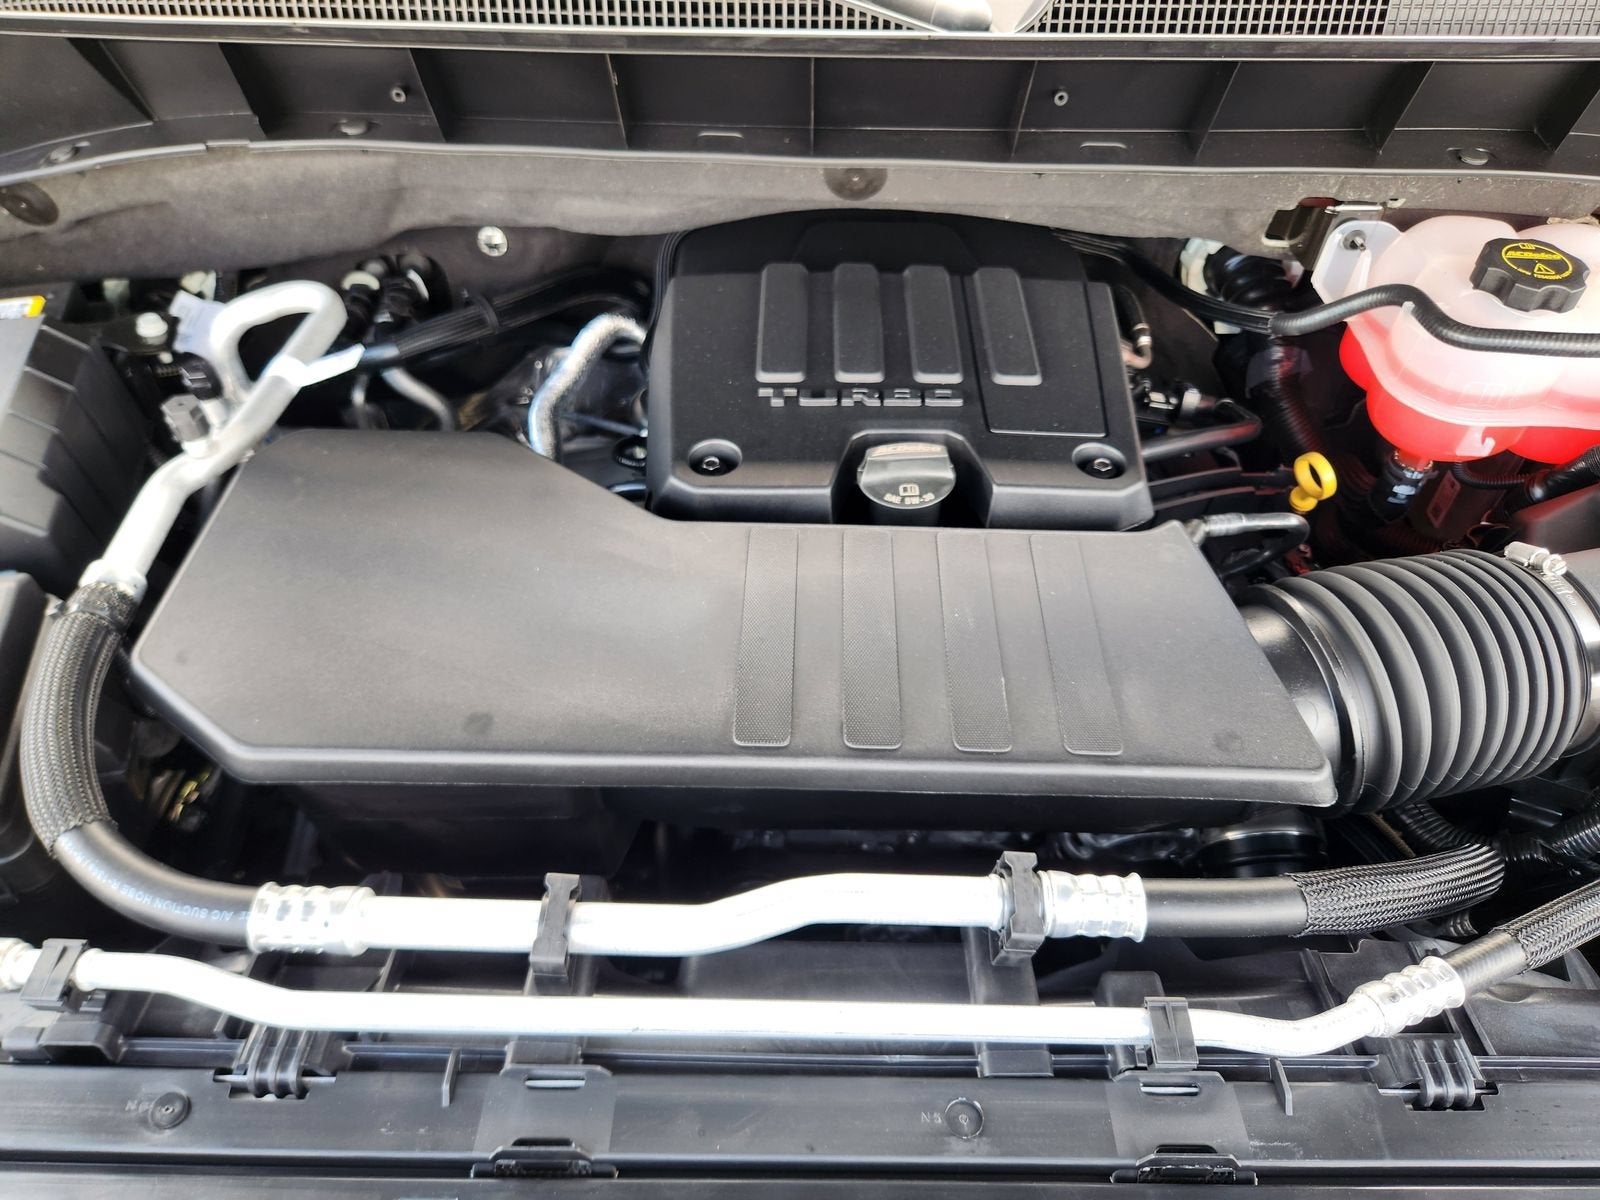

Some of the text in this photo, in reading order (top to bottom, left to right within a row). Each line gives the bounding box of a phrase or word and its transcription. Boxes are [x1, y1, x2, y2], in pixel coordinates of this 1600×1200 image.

[758, 387, 964, 407] TURBO
[119, 884, 152, 905] HOSE
[155, 896, 209, 919] SUCTION
[211, 909, 234, 922] A/C
